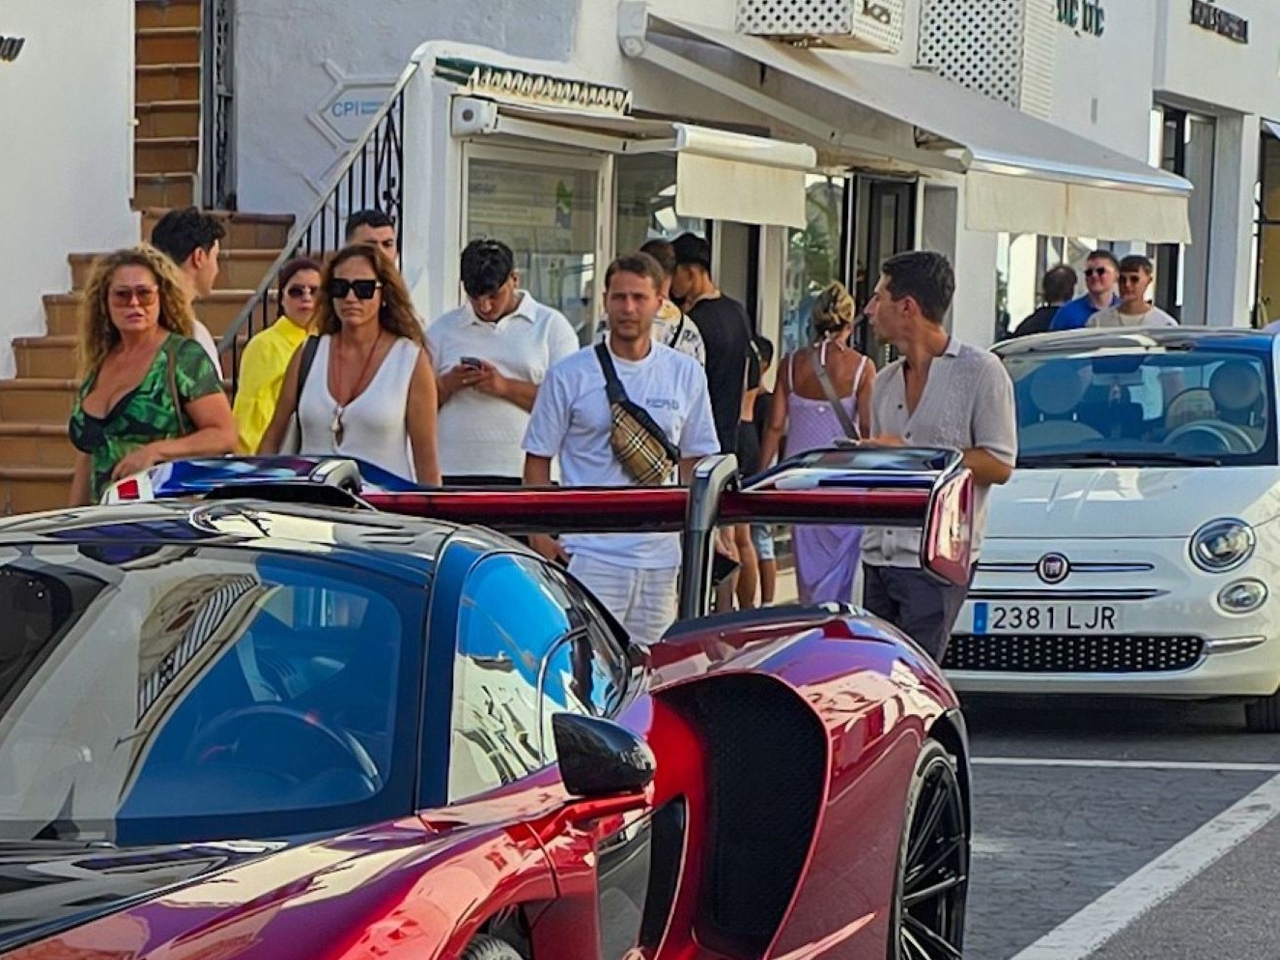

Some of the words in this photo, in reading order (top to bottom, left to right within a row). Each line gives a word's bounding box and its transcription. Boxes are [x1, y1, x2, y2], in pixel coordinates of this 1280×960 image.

[331, 101, 359, 117] CPI
[992, 606, 1054, 630] 2381
[1067, 606, 1116, 630] LJR
